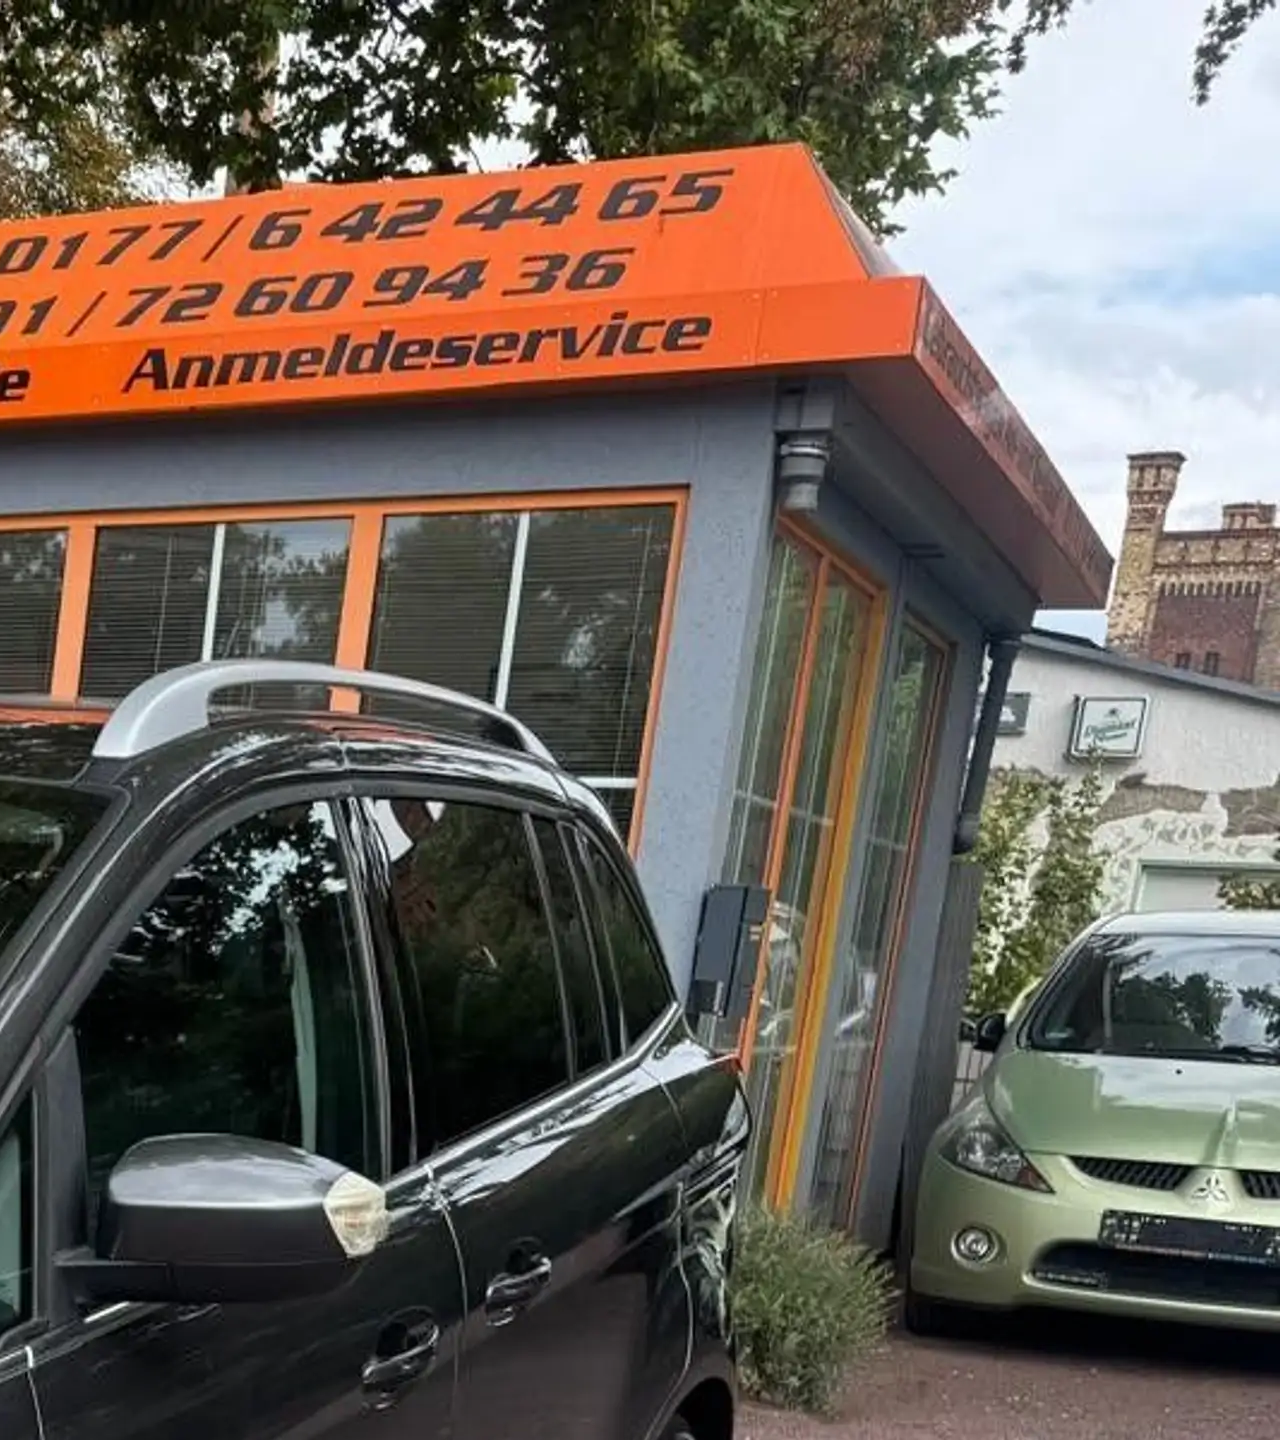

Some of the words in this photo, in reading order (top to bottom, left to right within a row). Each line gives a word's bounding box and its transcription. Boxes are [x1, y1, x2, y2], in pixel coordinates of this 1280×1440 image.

[320, 198, 443, 243] 42
[454, 182, 583, 231] 44
[597, 168, 734, 220] 65
[234, 271, 355, 318] 60
[362, 256, 491, 308] 94
[501, 247, 636, 297] 36
[121, 311, 713, 393] Anmeldeservice
